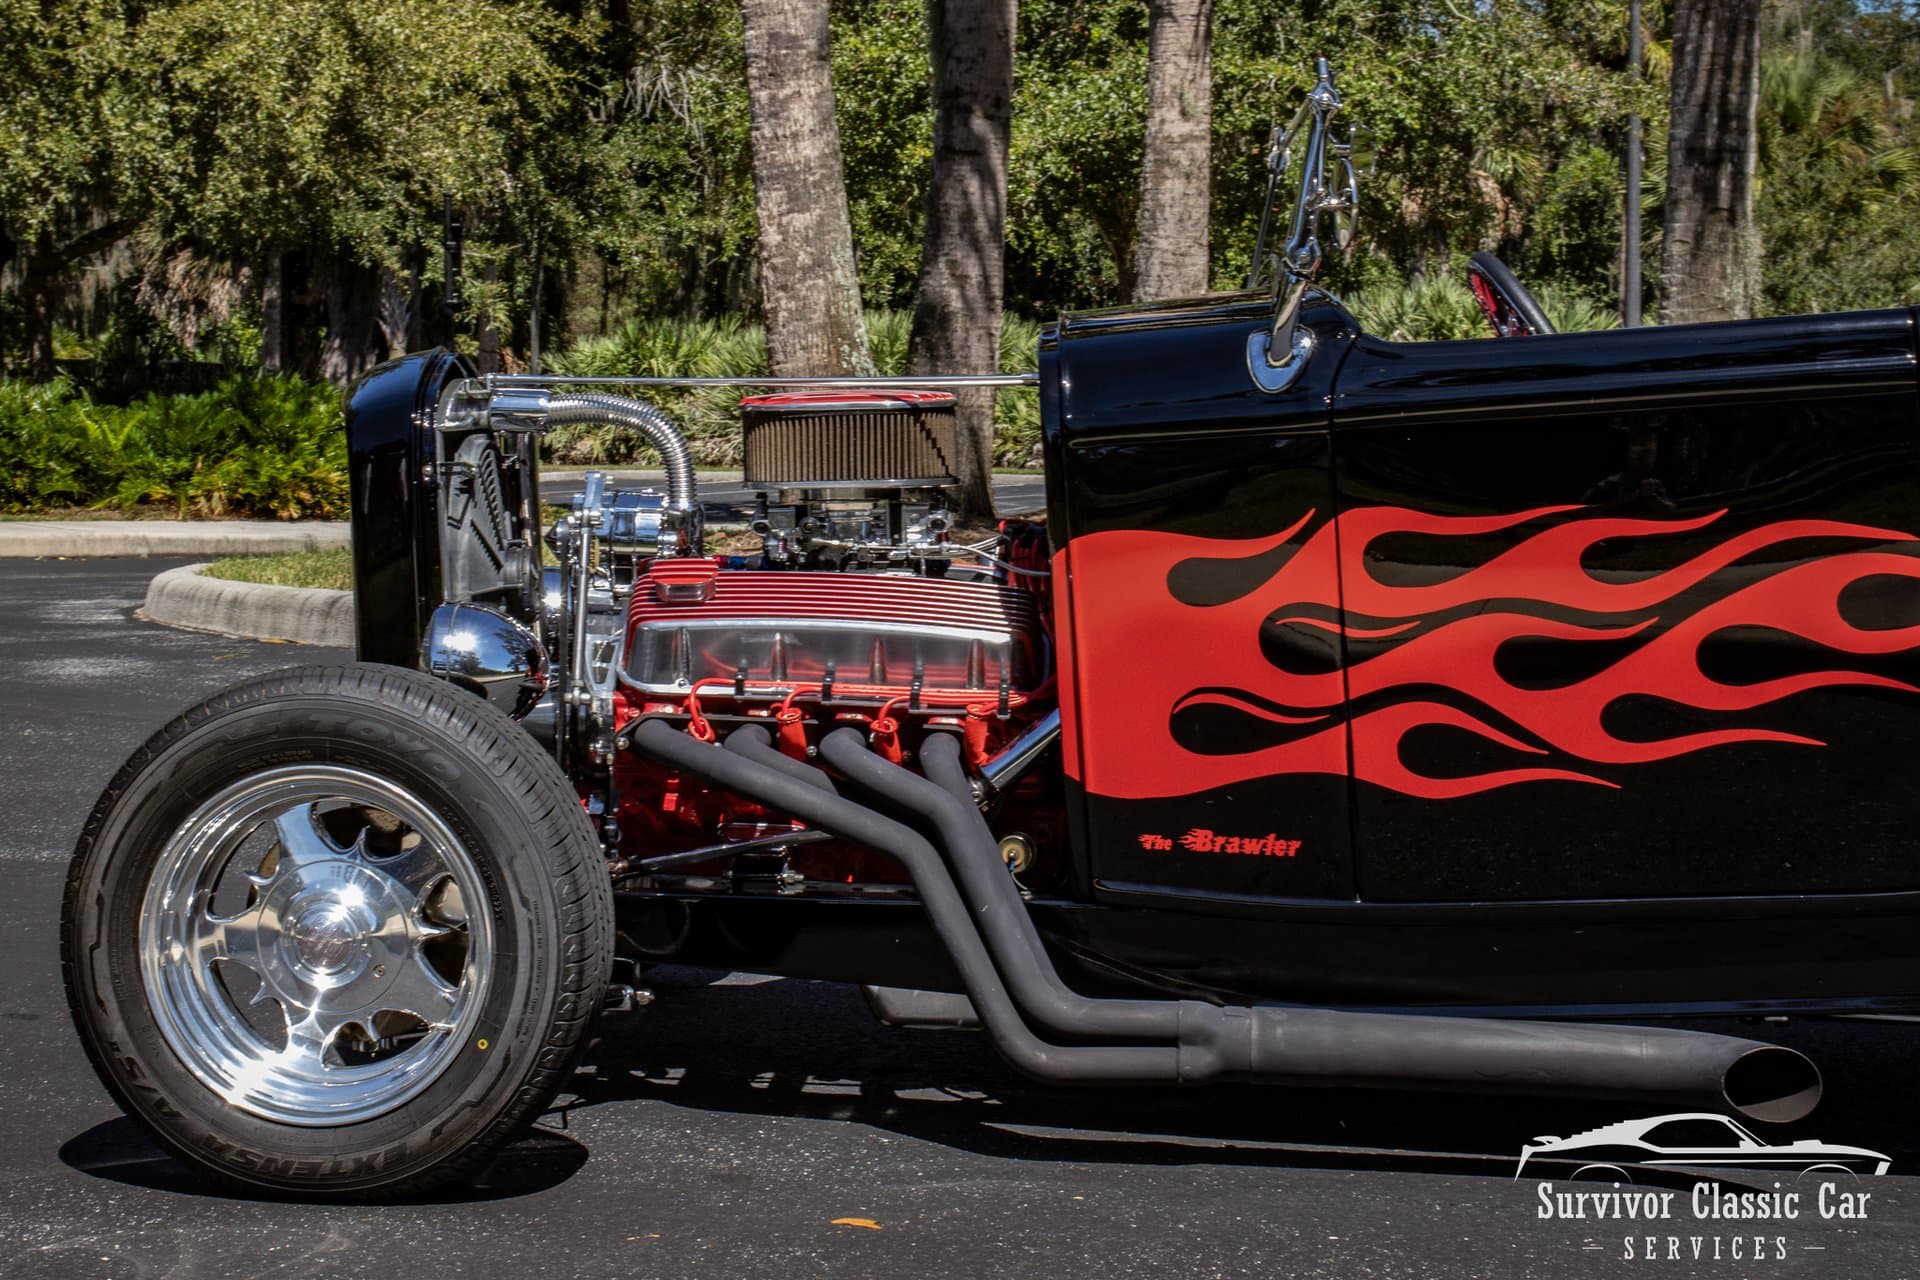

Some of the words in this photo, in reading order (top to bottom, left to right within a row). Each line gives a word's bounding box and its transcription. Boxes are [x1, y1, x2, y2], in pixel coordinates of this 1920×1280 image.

[308, 712, 462, 781] TOYO
[1137, 834, 1172, 851] The
[1177, 828, 1302, 857] Brawler
[200, 1132, 413, 1178] EXTENSA
